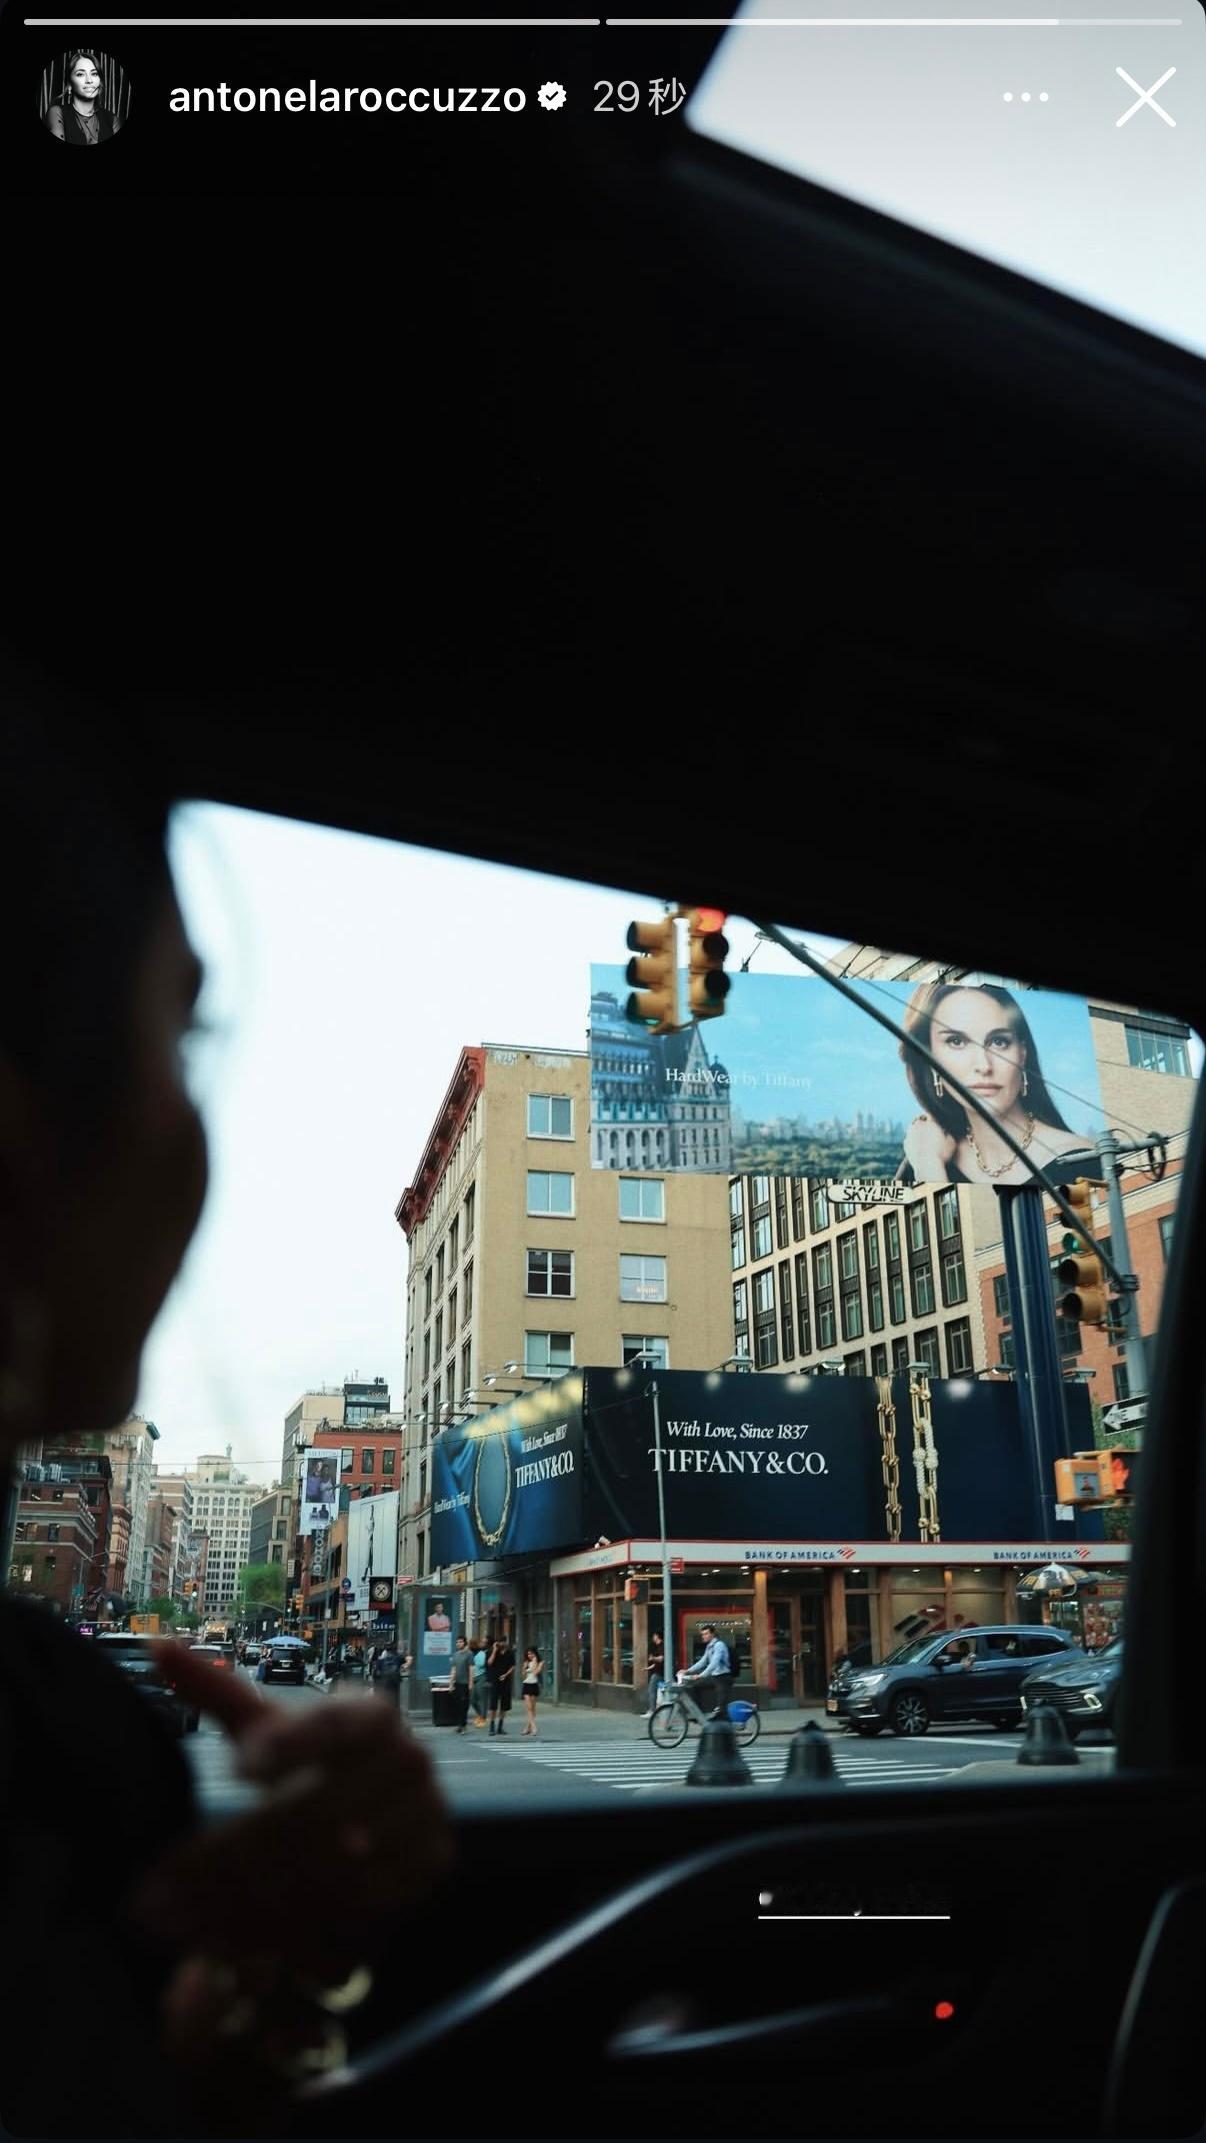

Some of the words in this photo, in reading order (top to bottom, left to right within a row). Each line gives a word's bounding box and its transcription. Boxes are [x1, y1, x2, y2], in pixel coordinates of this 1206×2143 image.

[665, 1067, 737, 1084] HardWear
[742, 1070, 757, 1088] by
[842, 1186, 905, 1202] SKYLINE
[666, 1420, 701, 1437] With
[704, 1422, 737, 1440] Love,
[740, 1423, 774, 1439] Since
[776, 1424, 809, 1440] 1837
[647, 1448, 829, 1475] TIFFANY&CO.
[744, 1551, 773, 1559] BANK
[775, 1551, 788, 1559] OF
[790, 1551, 835, 1560] AMERICA
[993, 1551, 1018, 1560] BANK
[1020, 1551, 1032, 1560] OF
[1034, 1551, 1073, 1560] AMERICA
